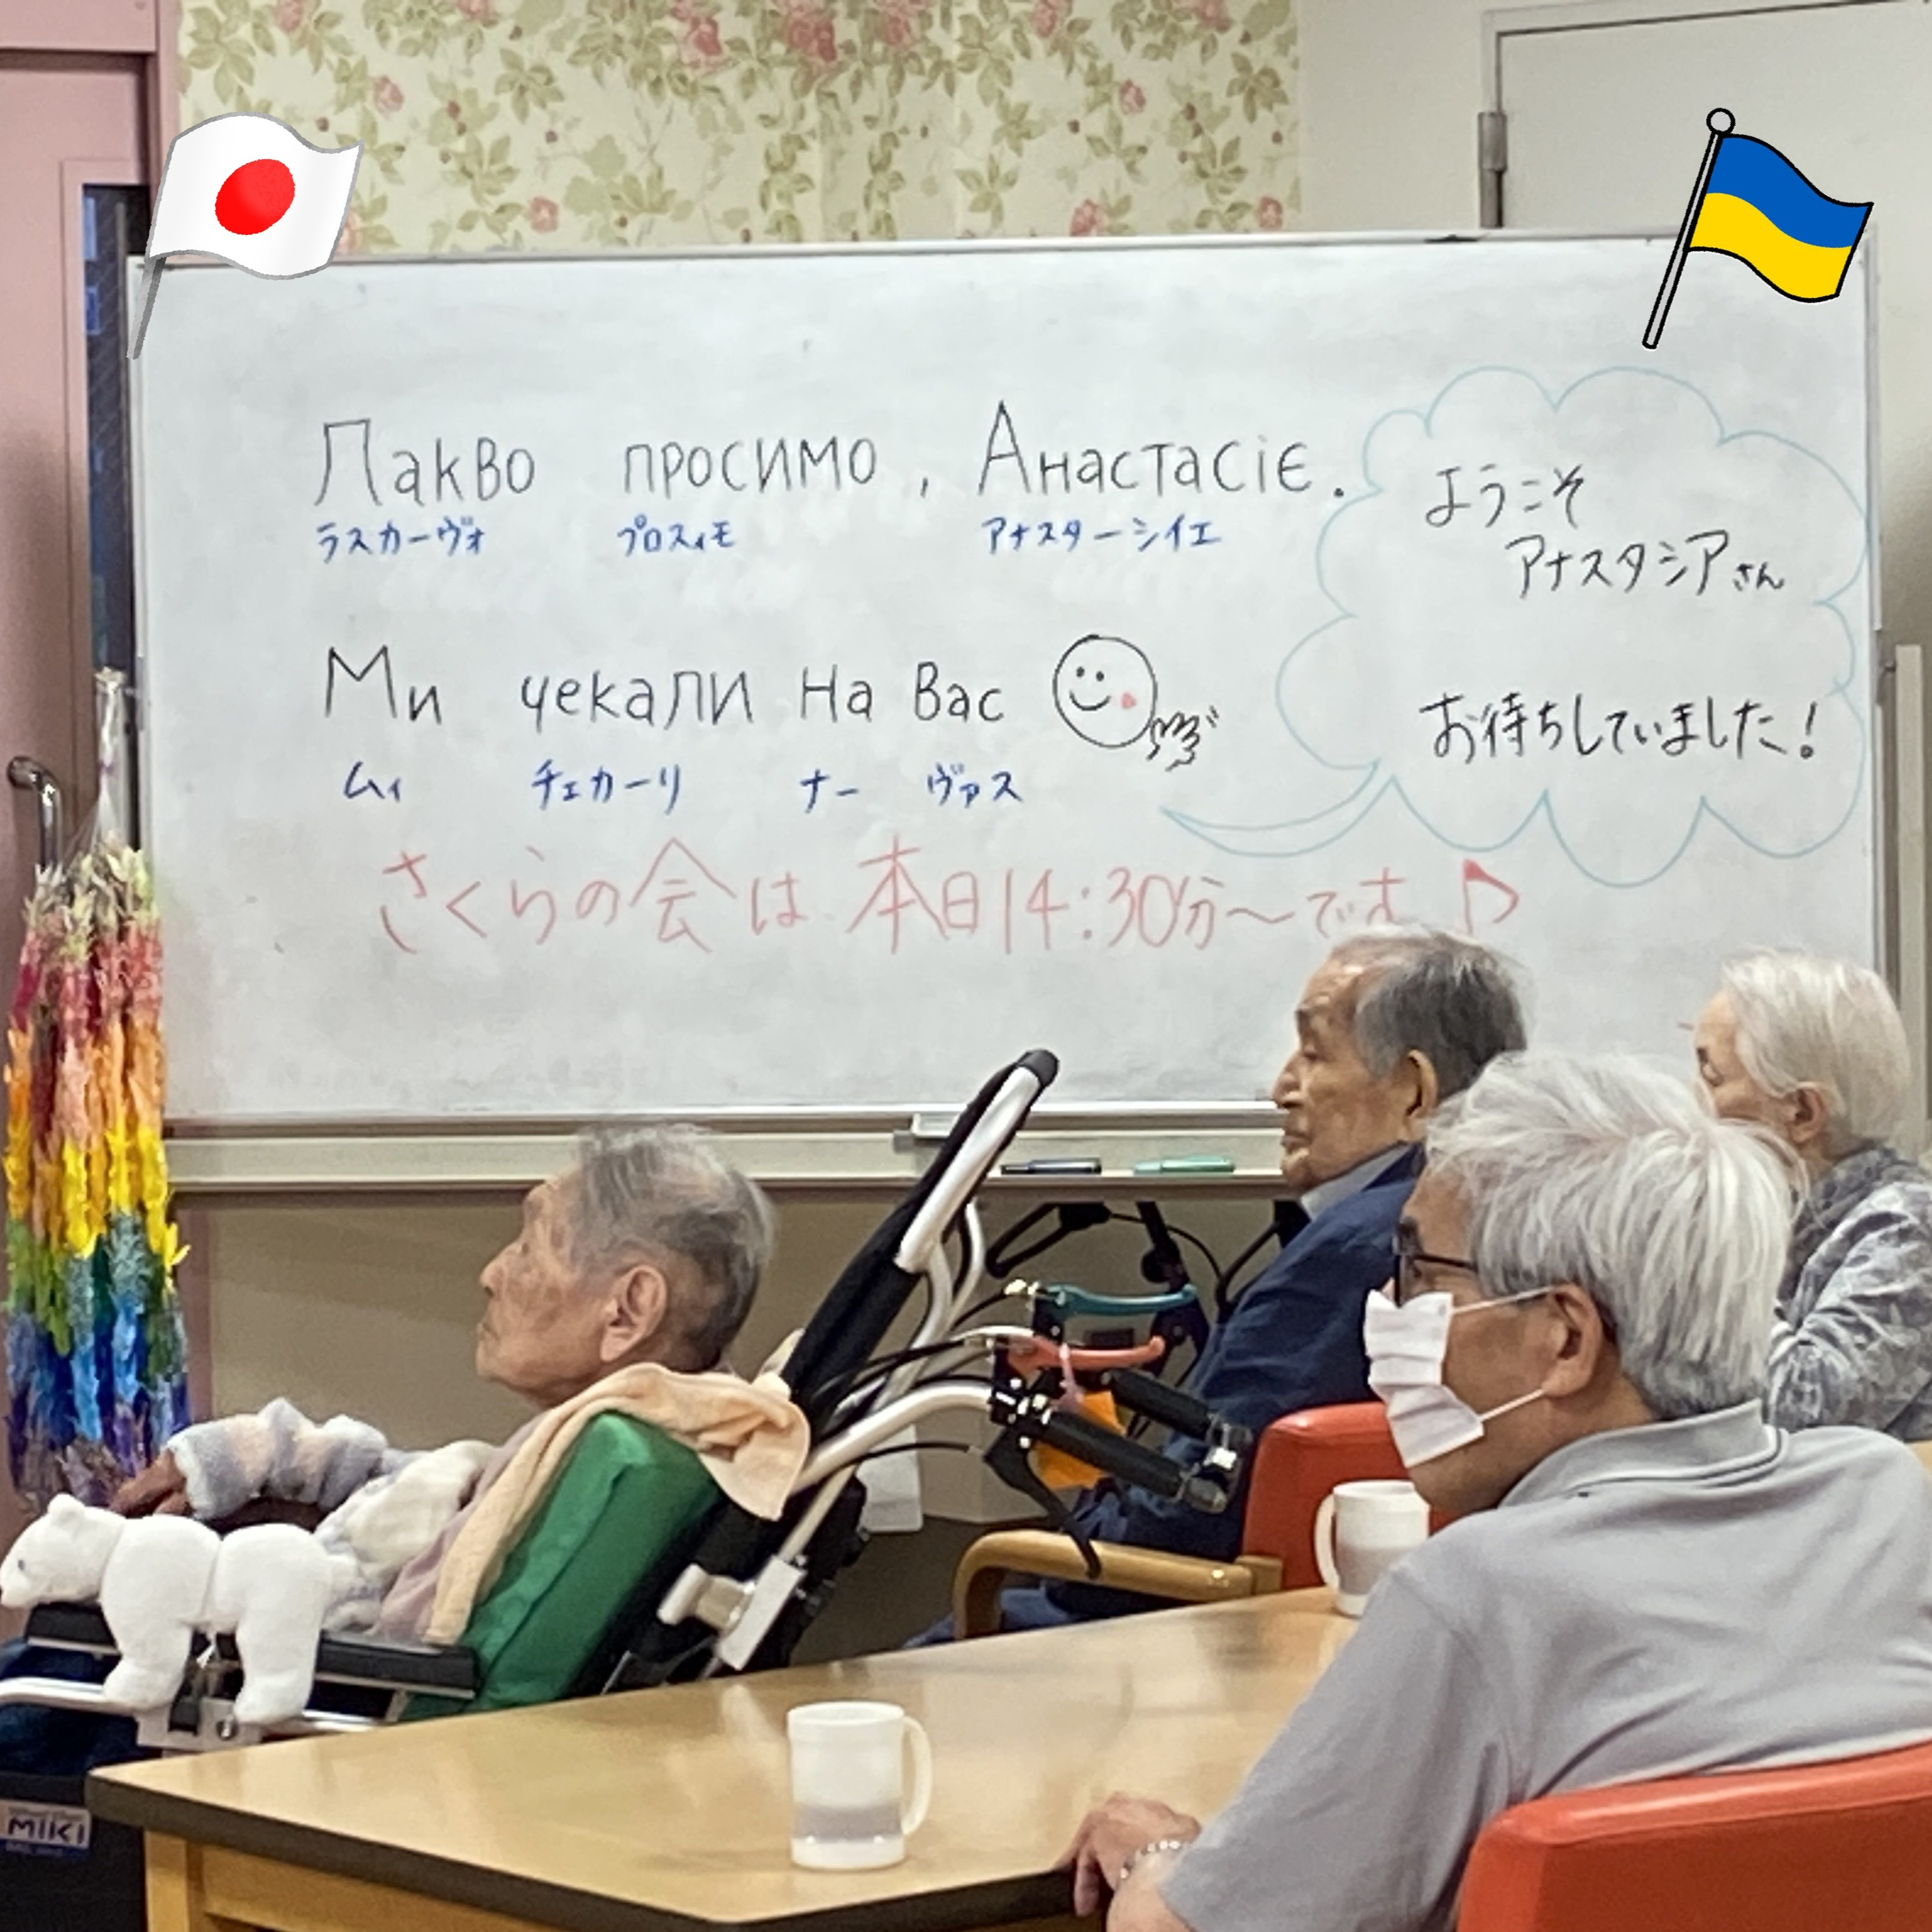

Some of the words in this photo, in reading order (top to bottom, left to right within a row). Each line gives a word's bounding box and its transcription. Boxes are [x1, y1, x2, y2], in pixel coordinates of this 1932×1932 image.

[1425, 463, 1584, 529] ようこそ
[1505, 529, 1785, 600] アナスタシアさん
[325, 645, 442, 725] Ми
[799, 769, 859, 814] ナー
[8, 1817, 85, 1845] MIKI
